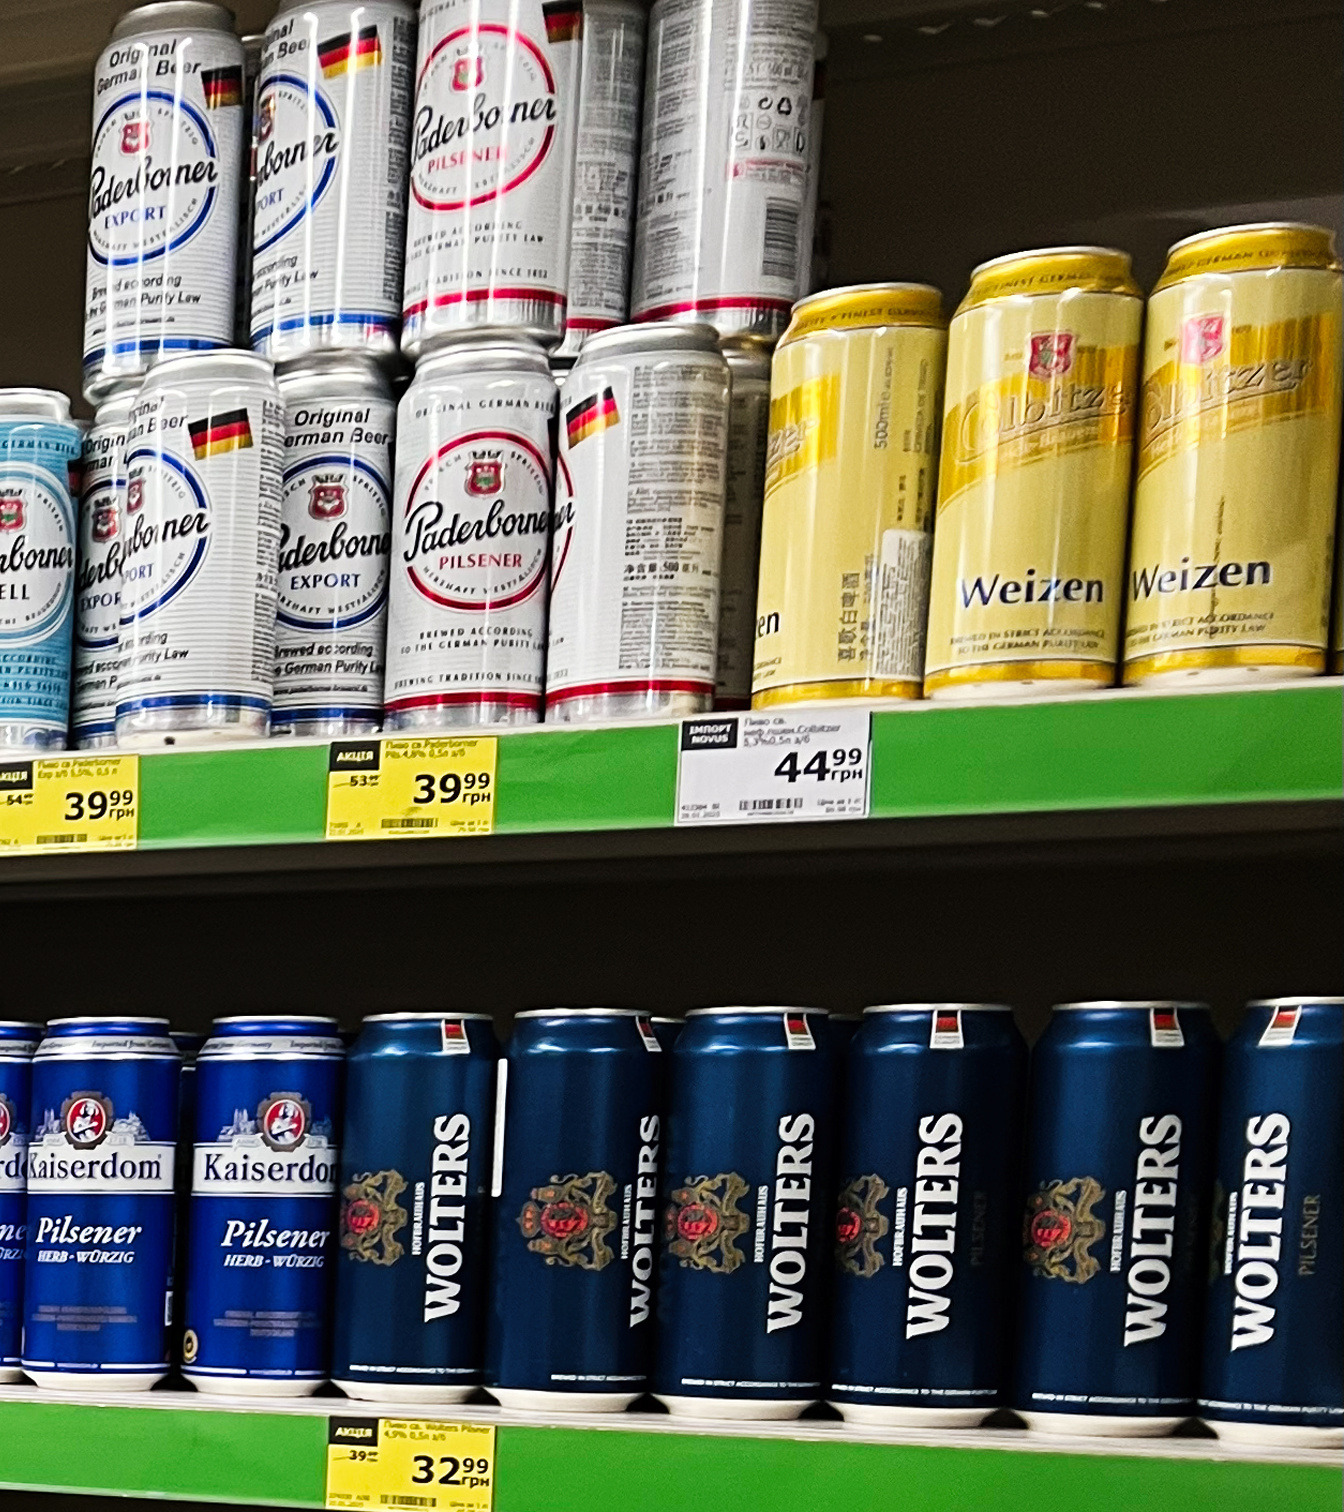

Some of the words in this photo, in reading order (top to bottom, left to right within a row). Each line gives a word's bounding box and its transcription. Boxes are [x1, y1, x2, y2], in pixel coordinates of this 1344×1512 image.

[293, 408, 371, 428] Original
[350, 426, 390, 446] Beer
[439, 551, 523, 570] PILSENER
[290, 571, 360, 592] EXPORT
[957, 568, 1105, 610] Weizen
[1131, 557, 1272, 600] Weizen
[691, 735, 730, 745] NOVUS
[335, 749, 375, 764] АКЦІЯ
[774, 749, 831, 785] 44
[833, 748, 863, 767] 99
[412, 773, 460, 804] 39
[462, 772, 491, 790] 99
[63, 792, 108, 821] 39
[109, 790, 134, 807] 99
[27, 1150, 163, 1181] Kaiserdom
[35, 1217, 141, 1248] Pilsener
[423, 1112, 471, 1324] WOLTERS
[767, 1112, 815, 1334] WOLTERS
[906, 1112, 963, 1339] WOLTERS
[1123, 1112, 1183, 1348] WOLTERS
[1230, 1112, 1292, 1352] WOLTERS
[221, 1219, 330, 1251] Pilsener
[335, 1426, 373, 1440] АКЦІЯ
[411, 1455, 461, 1486] 32
[462, 1458, 489, 1474] 99
